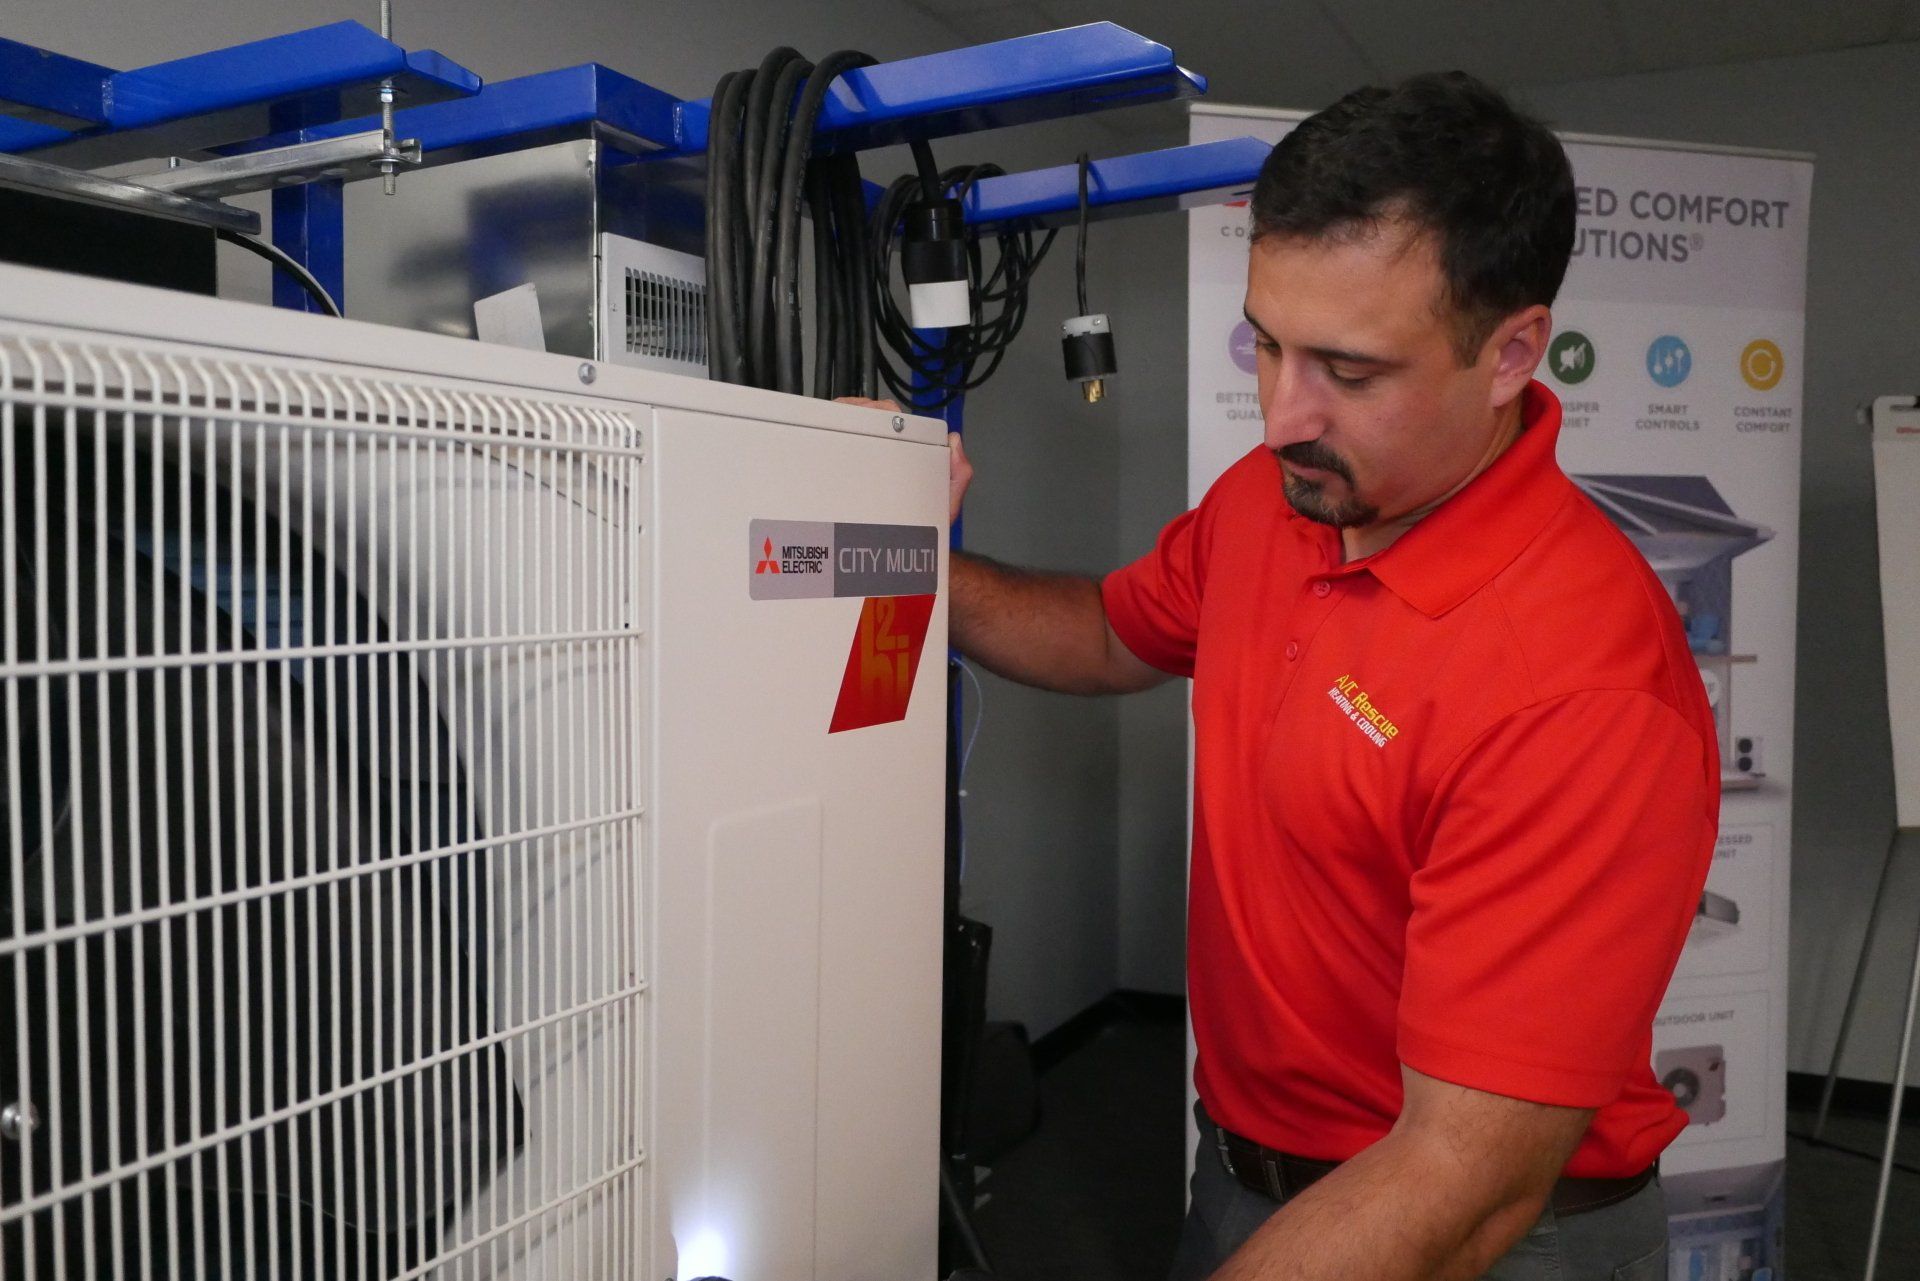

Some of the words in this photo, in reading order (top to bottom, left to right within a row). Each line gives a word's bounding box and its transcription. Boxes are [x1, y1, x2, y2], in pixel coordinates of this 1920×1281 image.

[1575, 186, 1618, 218] ED
[1630, 190, 1790, 229] COMFORT
[1221, 226, 1245, 238] CO
[1216, 392, 1259, 404] BETTE
[1562, 401, 1600, 413] ISPER
[1648, 403, 1690, 415] SMART
[1734, 406, 1793, 419] CONSTANT
[1562, 416, 1591, 428] UIET
[1634, 418, 1700, 432] CONTROLS
[1736, 421, 1792, 433] COMFORT
[782, 546, 829, 560] MITSUBISHI
[782, 560, 823, 574] ELECTRIC
[839, 547, 882, 574] CITY
[886, 548, 935, 574] MULTI
[1327, 686, 1355, 716] HEATING
[1349, 711, 1360, 722] &
[1356, 717, 1388, 748] COOLING
[1351, 691, 1399, 740] Rescue
[1709, 1009, 1735, 1022] UNIT
